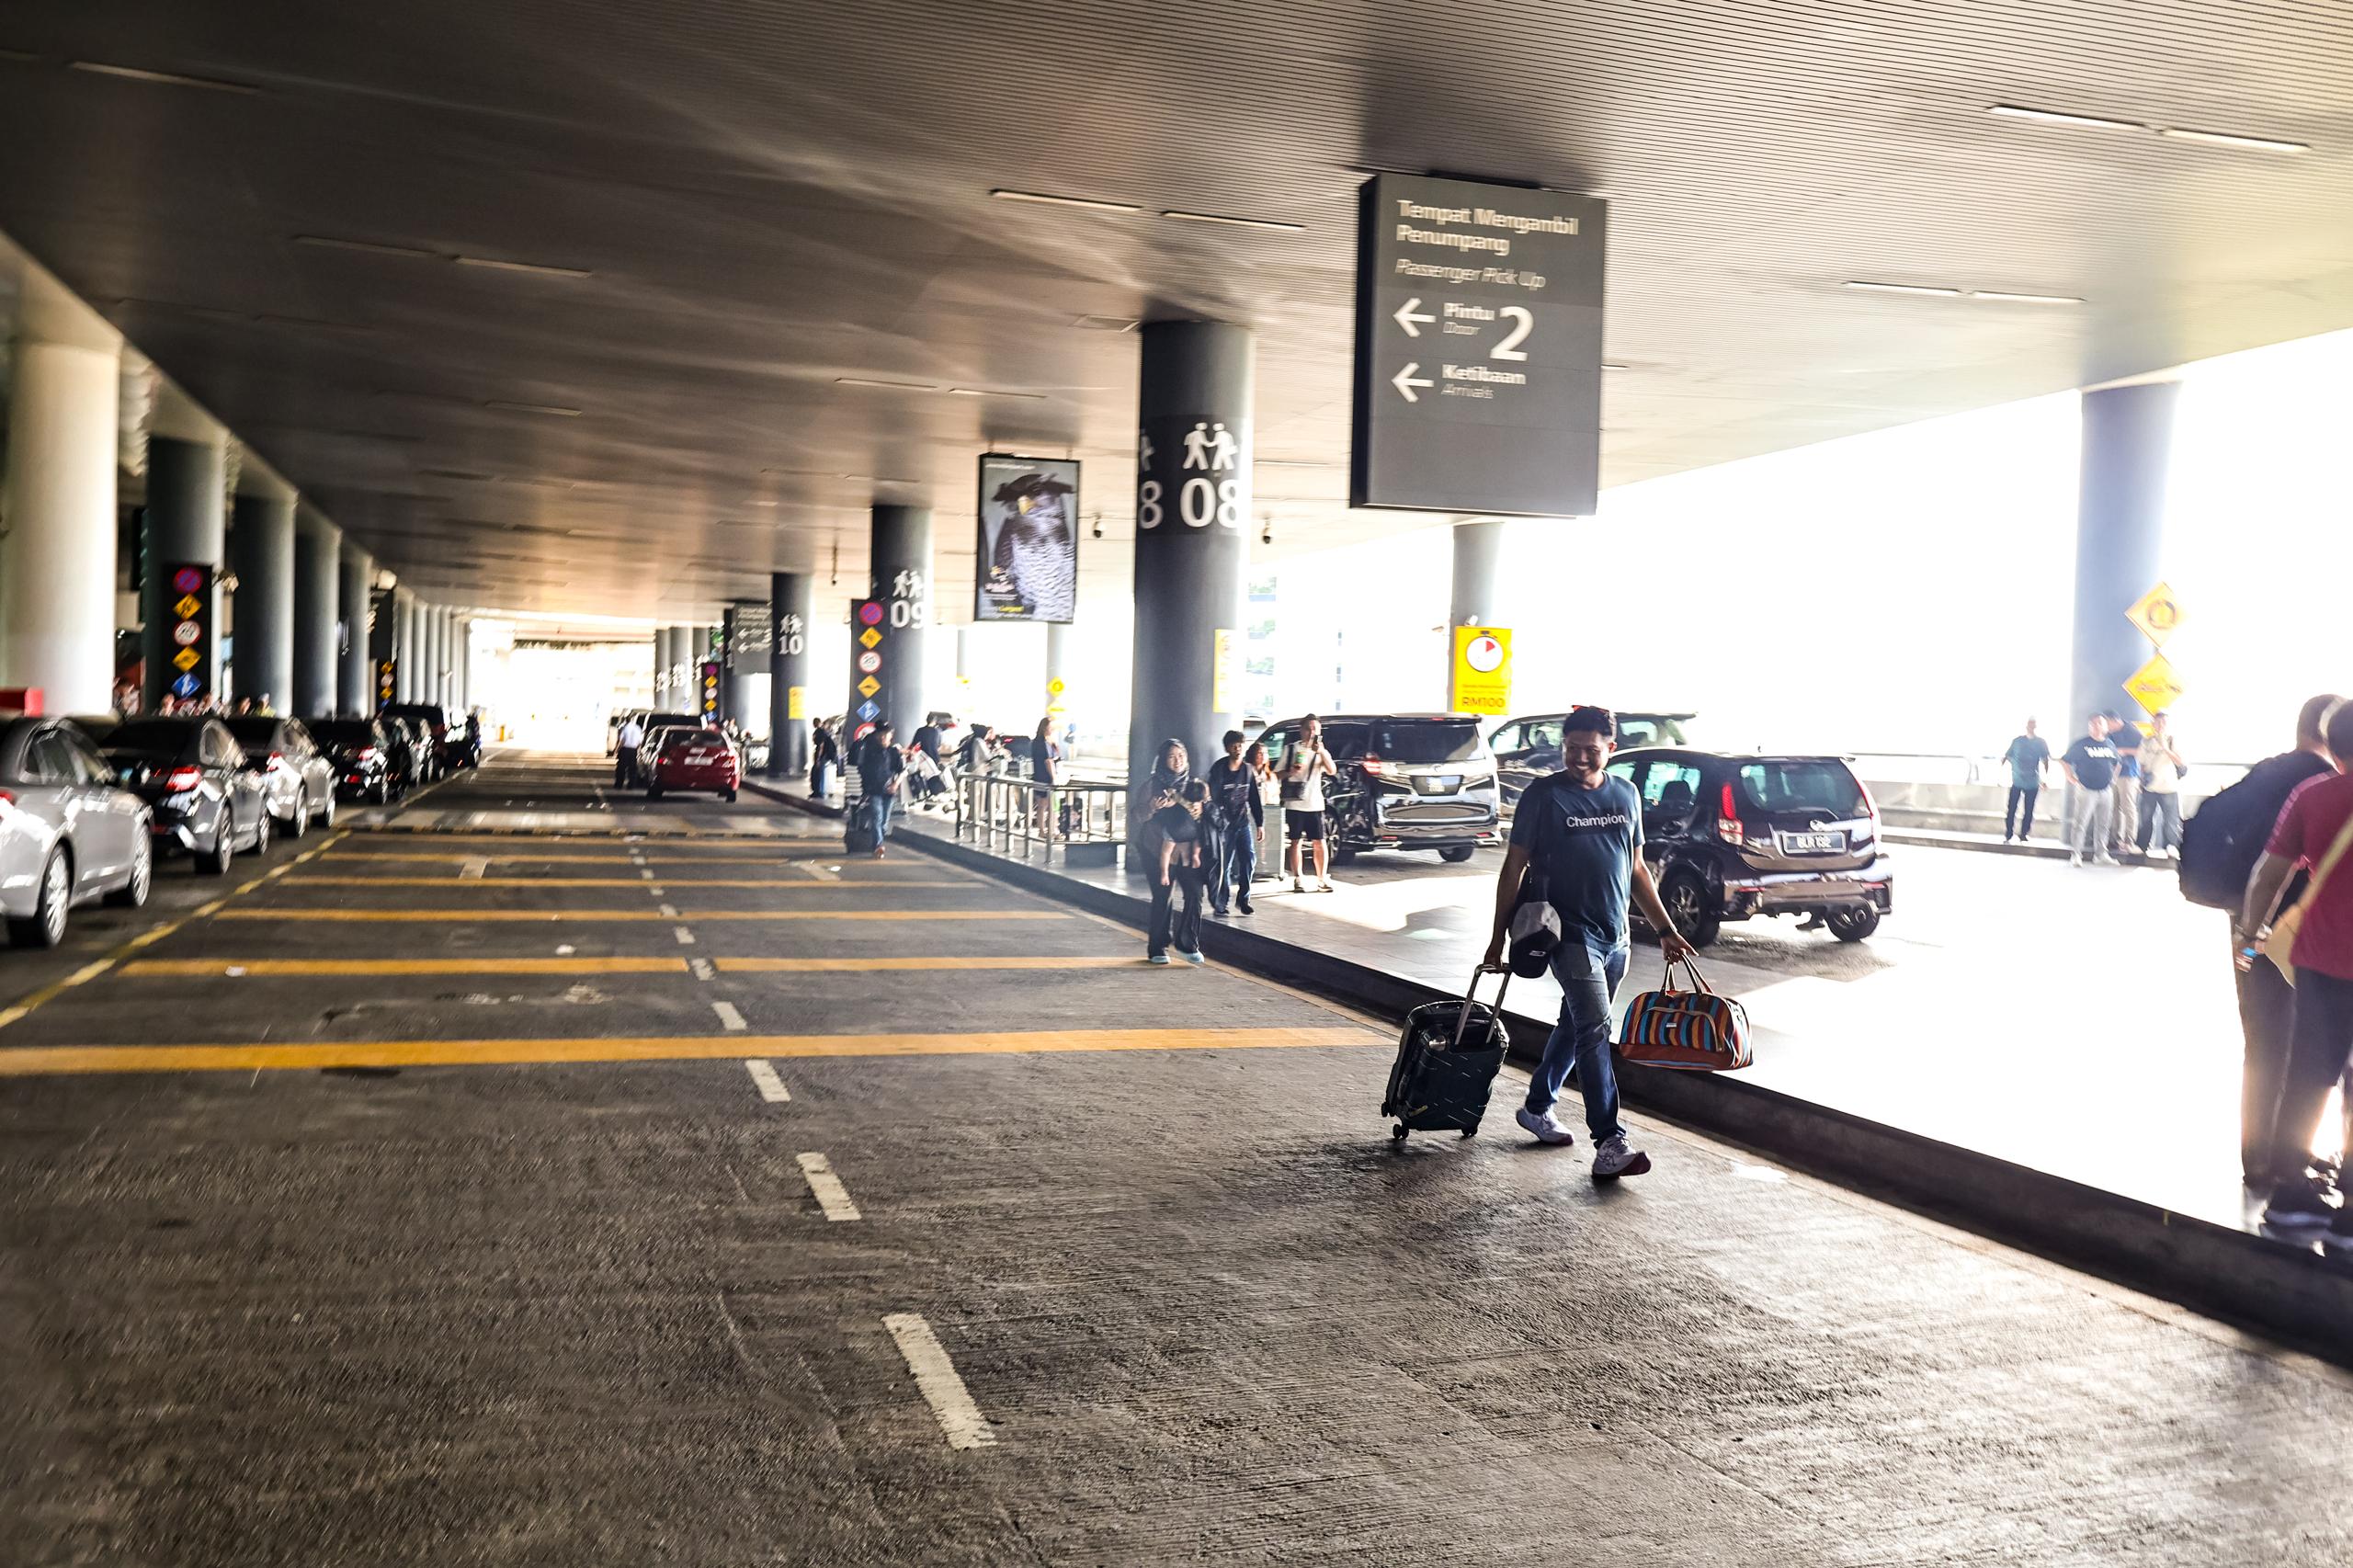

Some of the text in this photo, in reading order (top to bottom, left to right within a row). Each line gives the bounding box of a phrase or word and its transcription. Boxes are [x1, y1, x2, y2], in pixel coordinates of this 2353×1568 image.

[1396, 199, 1579, 235] Tempat Mengambil
[1396, 224, 1510, 256] Penumpang
[1395, 258, 1483, 284] Passenger
[1517, 270, 1546, 291] Up
[1443, 302, 1534, 361] Pintu 2
[1441, 364, 1526, 385] Ketibaan
[1179, 477, 1239, 528] 08
[890, 599, 925, 630] 09
[779, 634, 804, 655] 10
[1461, 697, 1506, 708] RM100
